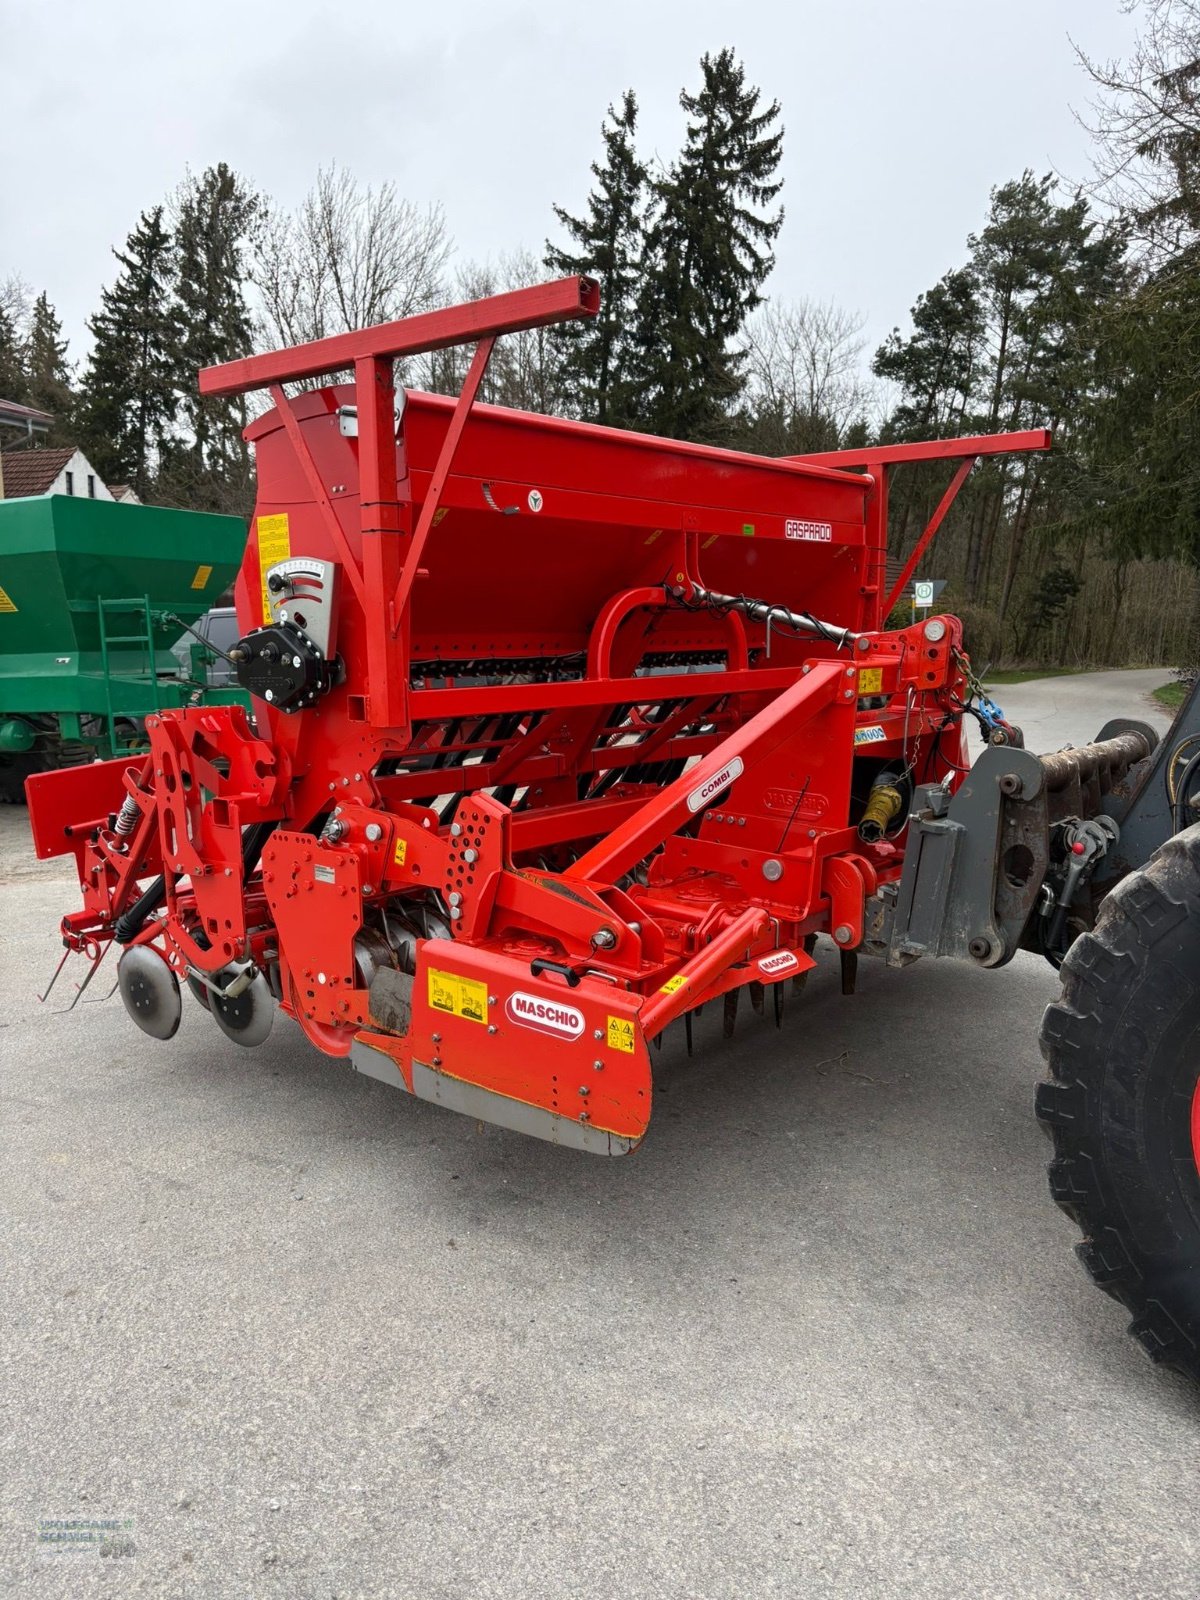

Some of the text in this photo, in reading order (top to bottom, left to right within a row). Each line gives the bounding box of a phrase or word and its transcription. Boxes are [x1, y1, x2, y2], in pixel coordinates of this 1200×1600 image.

[786, 521, 831, 540] GASPARDO
[701, 770, 730, 798] COMBI
[761, 954, 794, 970] MASCHIO
[515, 998, 579, 1029] MASCHIO
